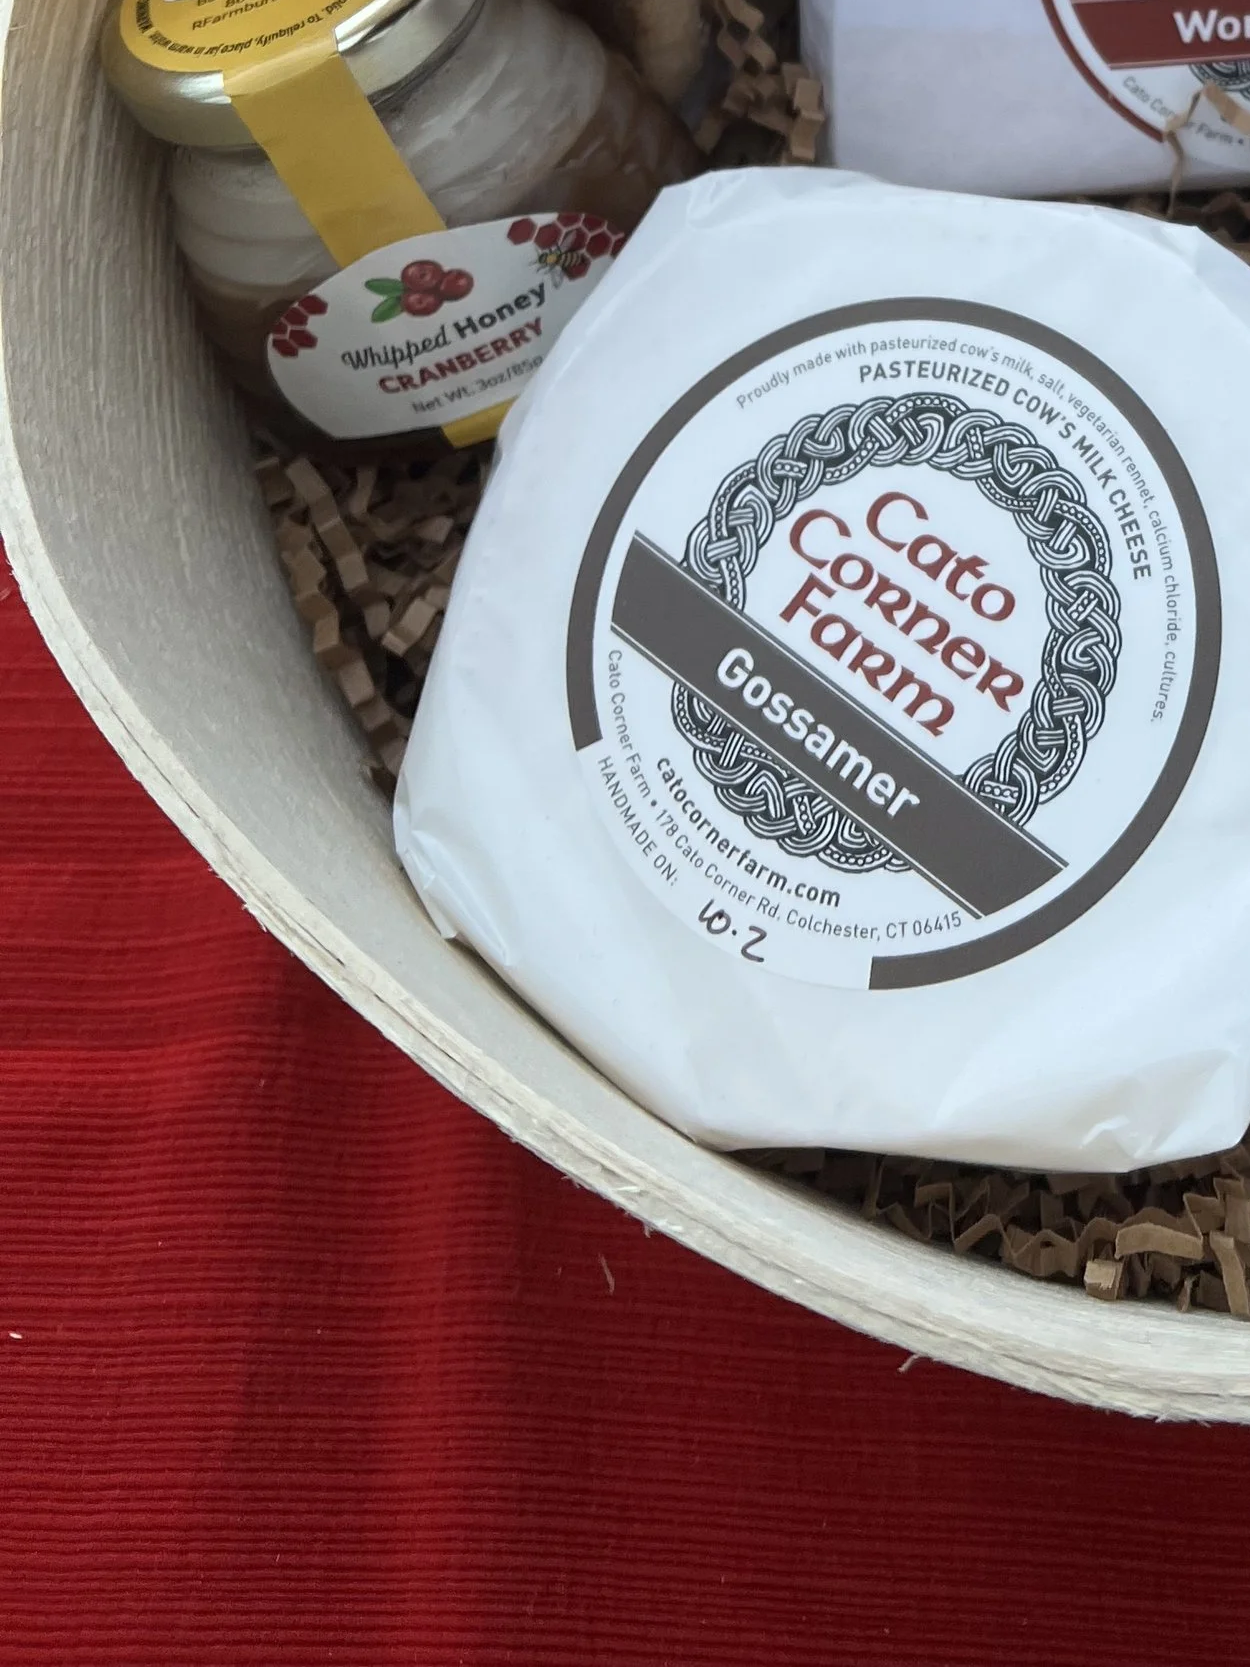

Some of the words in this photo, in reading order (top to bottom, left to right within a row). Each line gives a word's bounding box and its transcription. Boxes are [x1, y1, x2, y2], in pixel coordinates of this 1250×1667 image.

[341, 324, 452, 371] Whipped
[453, 282, 547, 340] Honey
[871, 334, 958, 355] pasteurized
[378, 316, 543, 394] CRANBERRY
[793, 353, 833, 378] made
[835, 342, 867, 361] with
[960, 342, 1000, 363] cow's
[1001, 355, 1034, 380] milk,
[411, 398, 443, 414] Net
[736, 369, 791, 410] Proudly
[1038, 373, 1066, 402] salt,
[1066, 391, 1125, 458] vegetarian
[859, 360, 1010, 398] PASTEURIZED
[1012, 387, 1074, 440] COW'S
[1071, 434, 1117, 492] MILK
[1108, 487, 1152, 581] CHEESE
[1119, 452, 1157, 510] rennet,
[865, 491, 1016, 624] Cato
[1148, 509, 1173, 572] calcium
[788, 507, 1027, 715] Corner
[1163, 574, 1181, 647] chloride,
[607, 649, 624, 690] Cato
[778, 575, 958, 739] Farm
[1149, 648, 1178, 724] cultures.
[607, 691, 634, 749] Corner
[716, 646, 921, 821] Gossamer
[624, 752, 652, 799] Farm
[596, 755, 661, 858] HANDMADE
[653, 851, 678, 887] ON:
[654, 807, 677, 838] 178
[656, 756, 842, 908] catocornerfarm.com
[674, 833, 706, 869] Cato
[704, 864, 757, 909] Corner
[786, 908, 881, 942] Colchester,
[885, 921, 908, 940] CT
[911, 910, 963, 936] 06415
